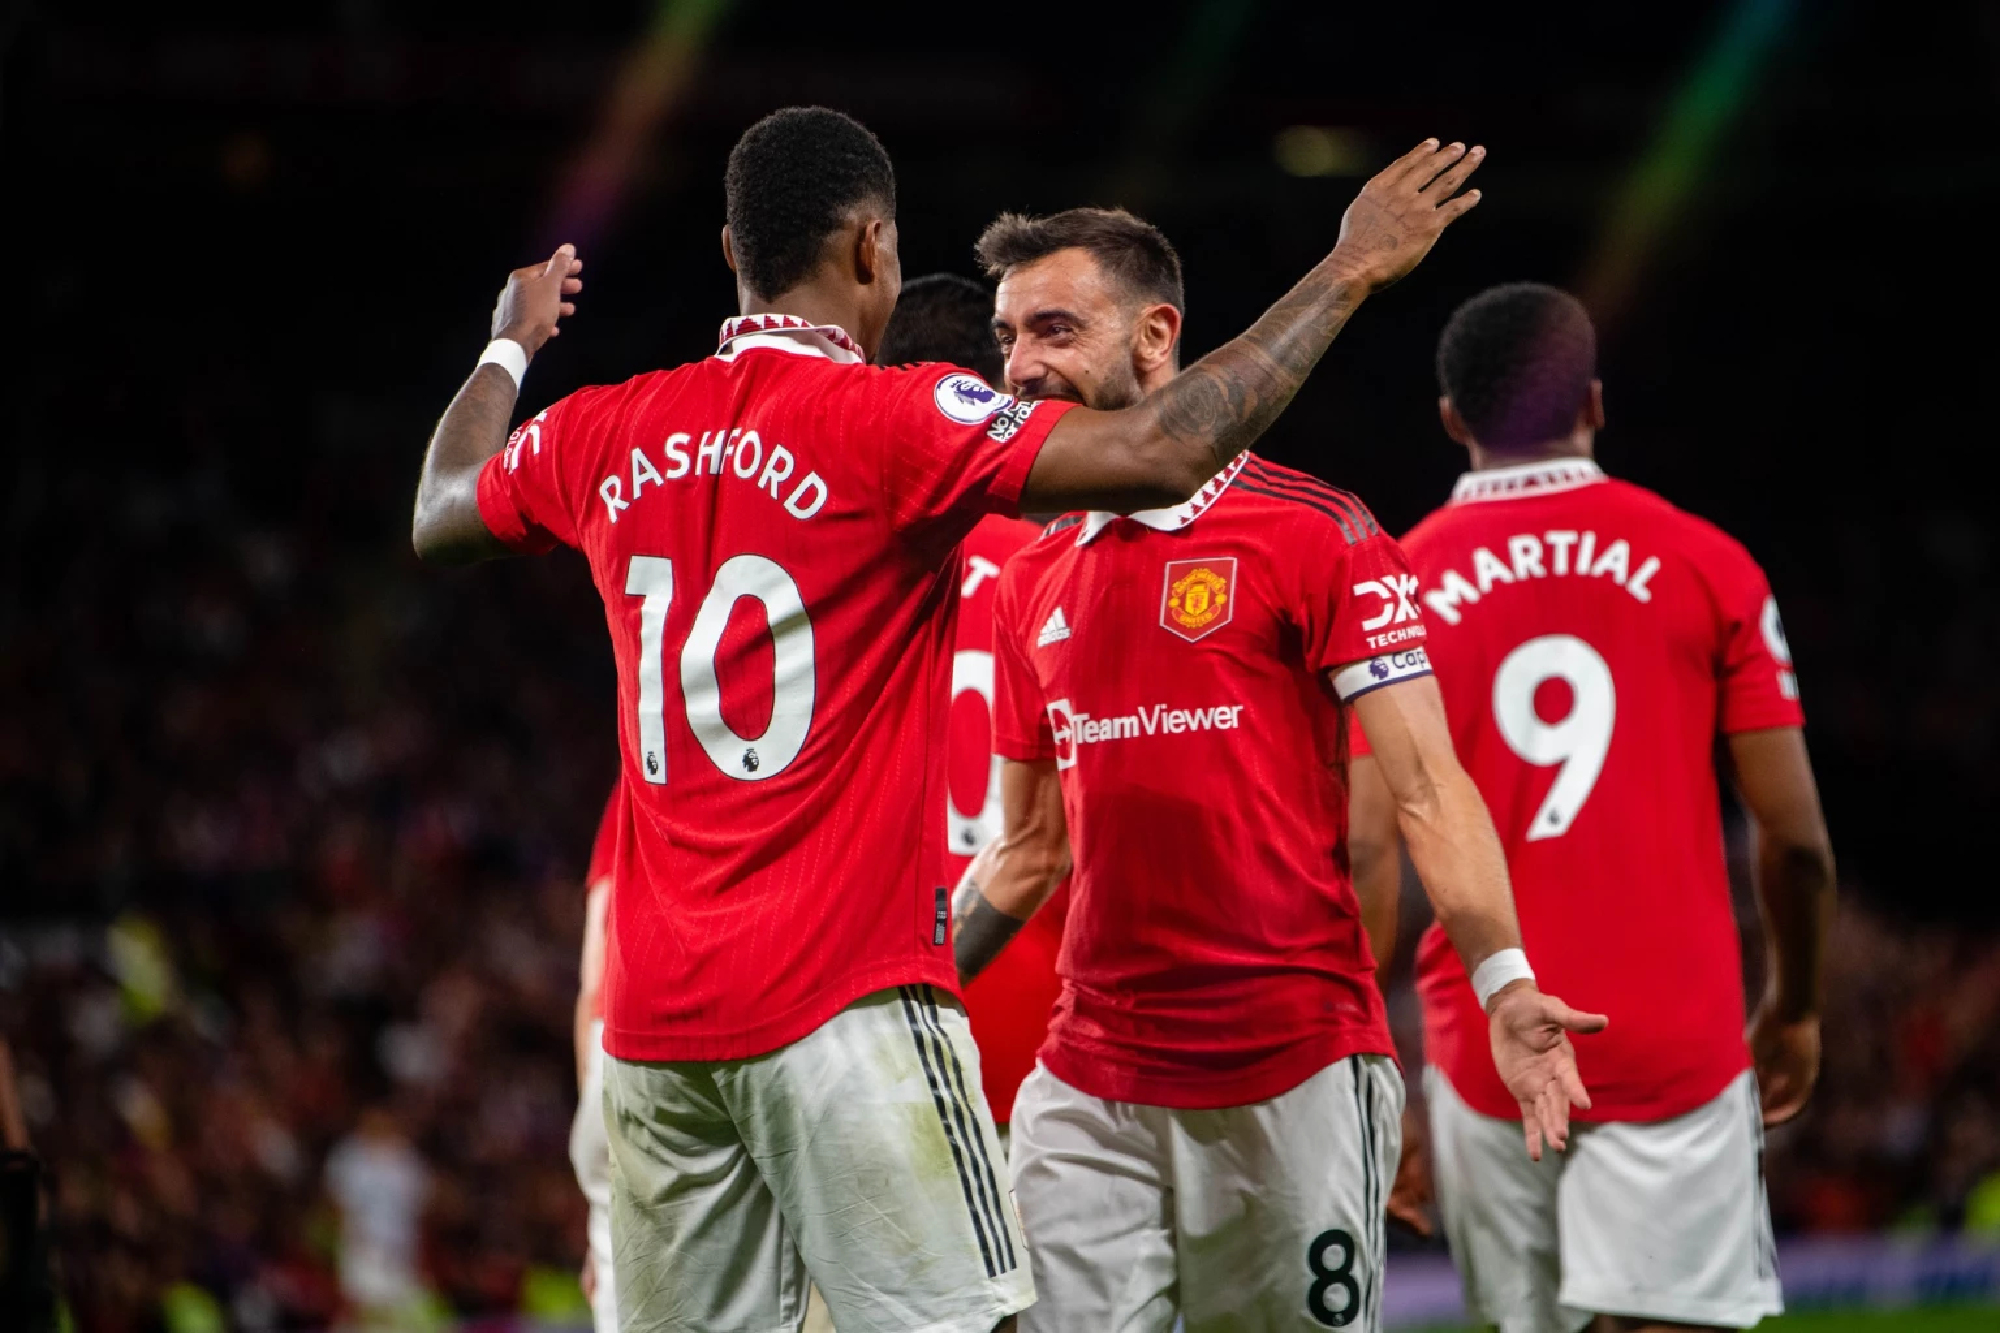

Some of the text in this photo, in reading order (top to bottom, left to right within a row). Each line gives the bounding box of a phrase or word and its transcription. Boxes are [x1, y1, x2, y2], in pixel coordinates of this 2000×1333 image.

[599, 427, 828, 524] RASHFORD
[1424, 530, 1661, 625] MARTIAL
[625, 554, 817, 786] 10
[1073, 703, 1244, 744] TeamViewer
[1492, 633, 1617, 842] 9
[1308, 1228, 1360, 1327] 8
